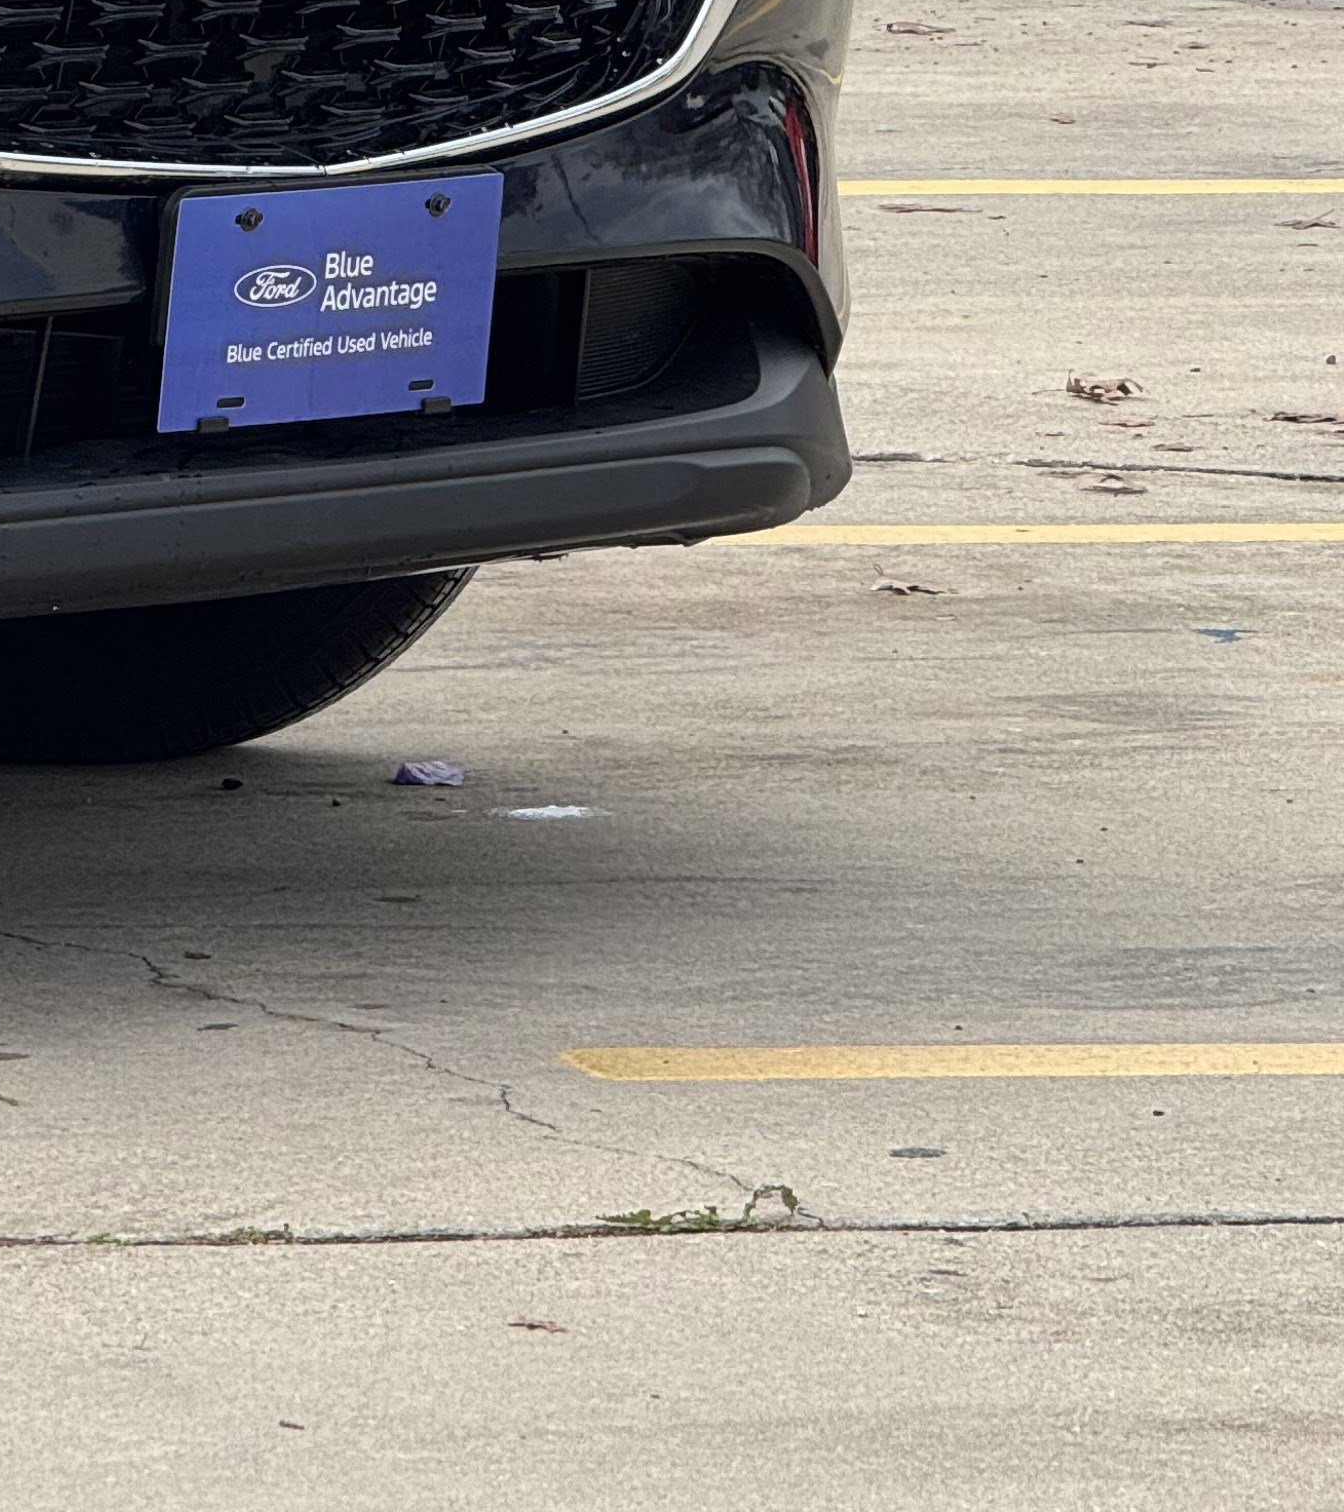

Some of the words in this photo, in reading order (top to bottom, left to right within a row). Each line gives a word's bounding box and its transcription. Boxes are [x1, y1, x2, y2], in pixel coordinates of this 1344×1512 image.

[324, 250, 374, 280] Blue
[249, 270, 303, 301] Ford
[319, 280, 437, 313] Advantage
[226, 344, 263, 364] Blue
[267, 336, 333, 360] Certified
[337, 332, 376, 354] Used
[380, 327, 433, 350] Vehicle
